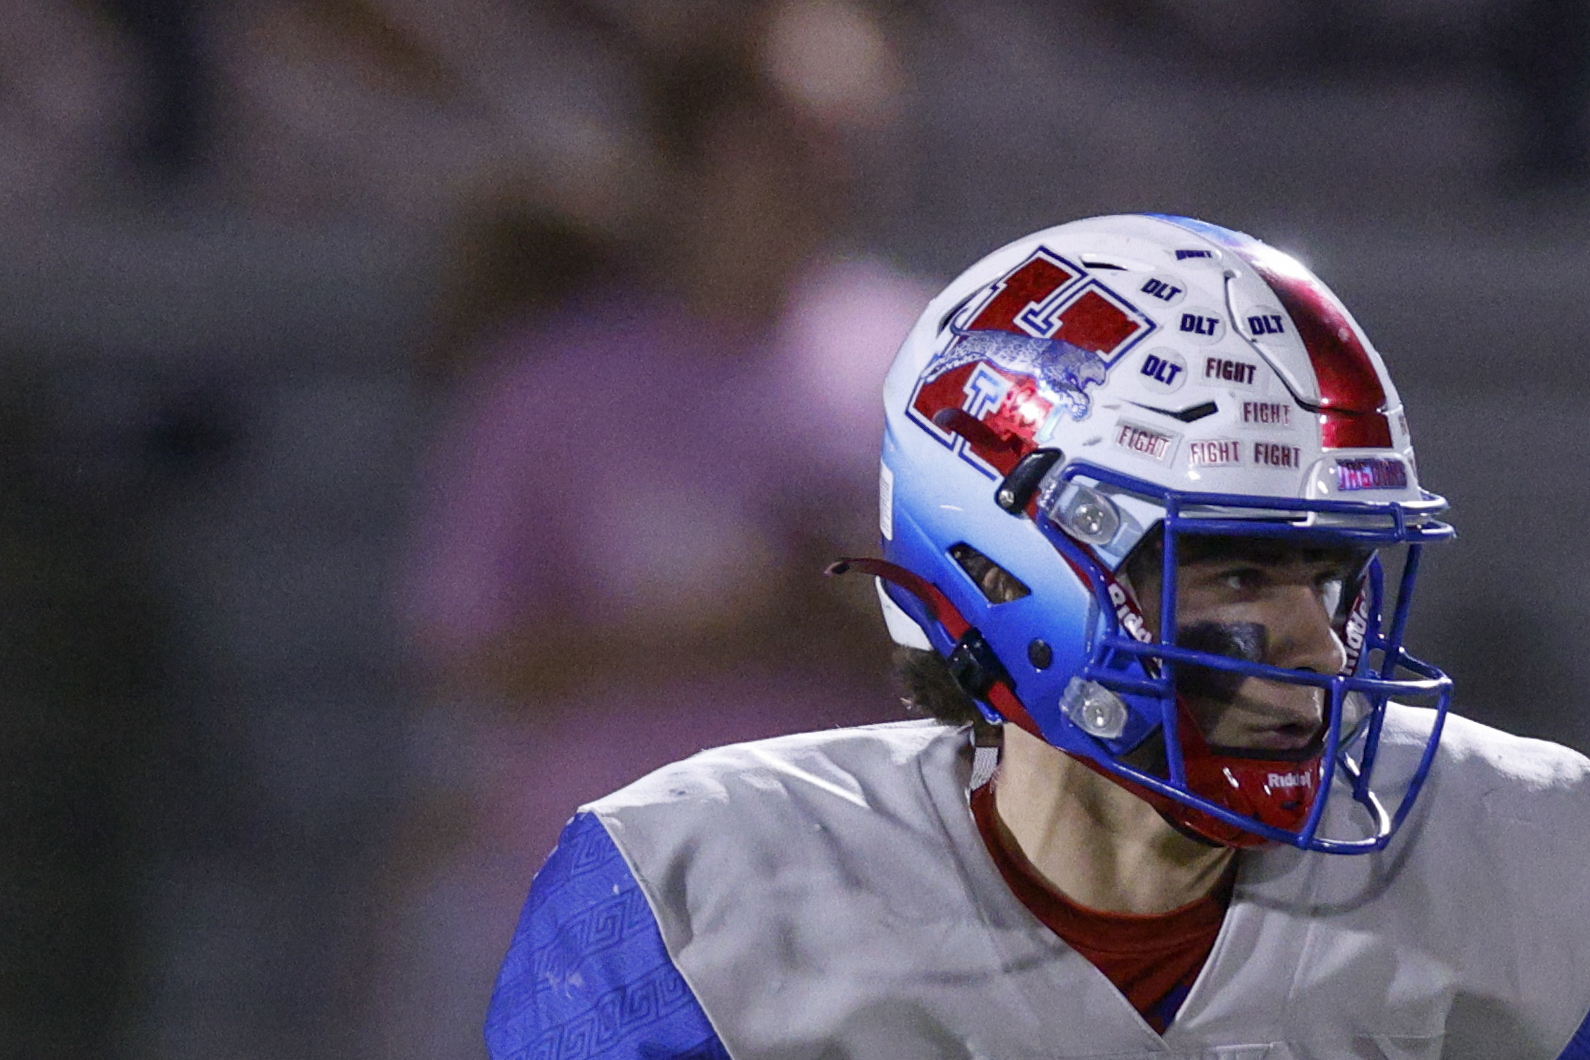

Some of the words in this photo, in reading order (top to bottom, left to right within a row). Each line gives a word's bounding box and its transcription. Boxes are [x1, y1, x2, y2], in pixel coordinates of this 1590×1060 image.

[1140, 278, 1181, 302] DLT
[1180, 313, 1219, 336] DLT
[1247, 314, 1285, 336] DLT
[1140, 355, 1182, 386] DLT
[1205, 357, 1257, 385] FIGHT
[1243, 402, 1291, 426] FIGHT
[1117, 425, 1172, 459] FIGHT
[1190, 441, 1241, 464] FIGHT
[1254, 443, 1301, 469] FIGHT
